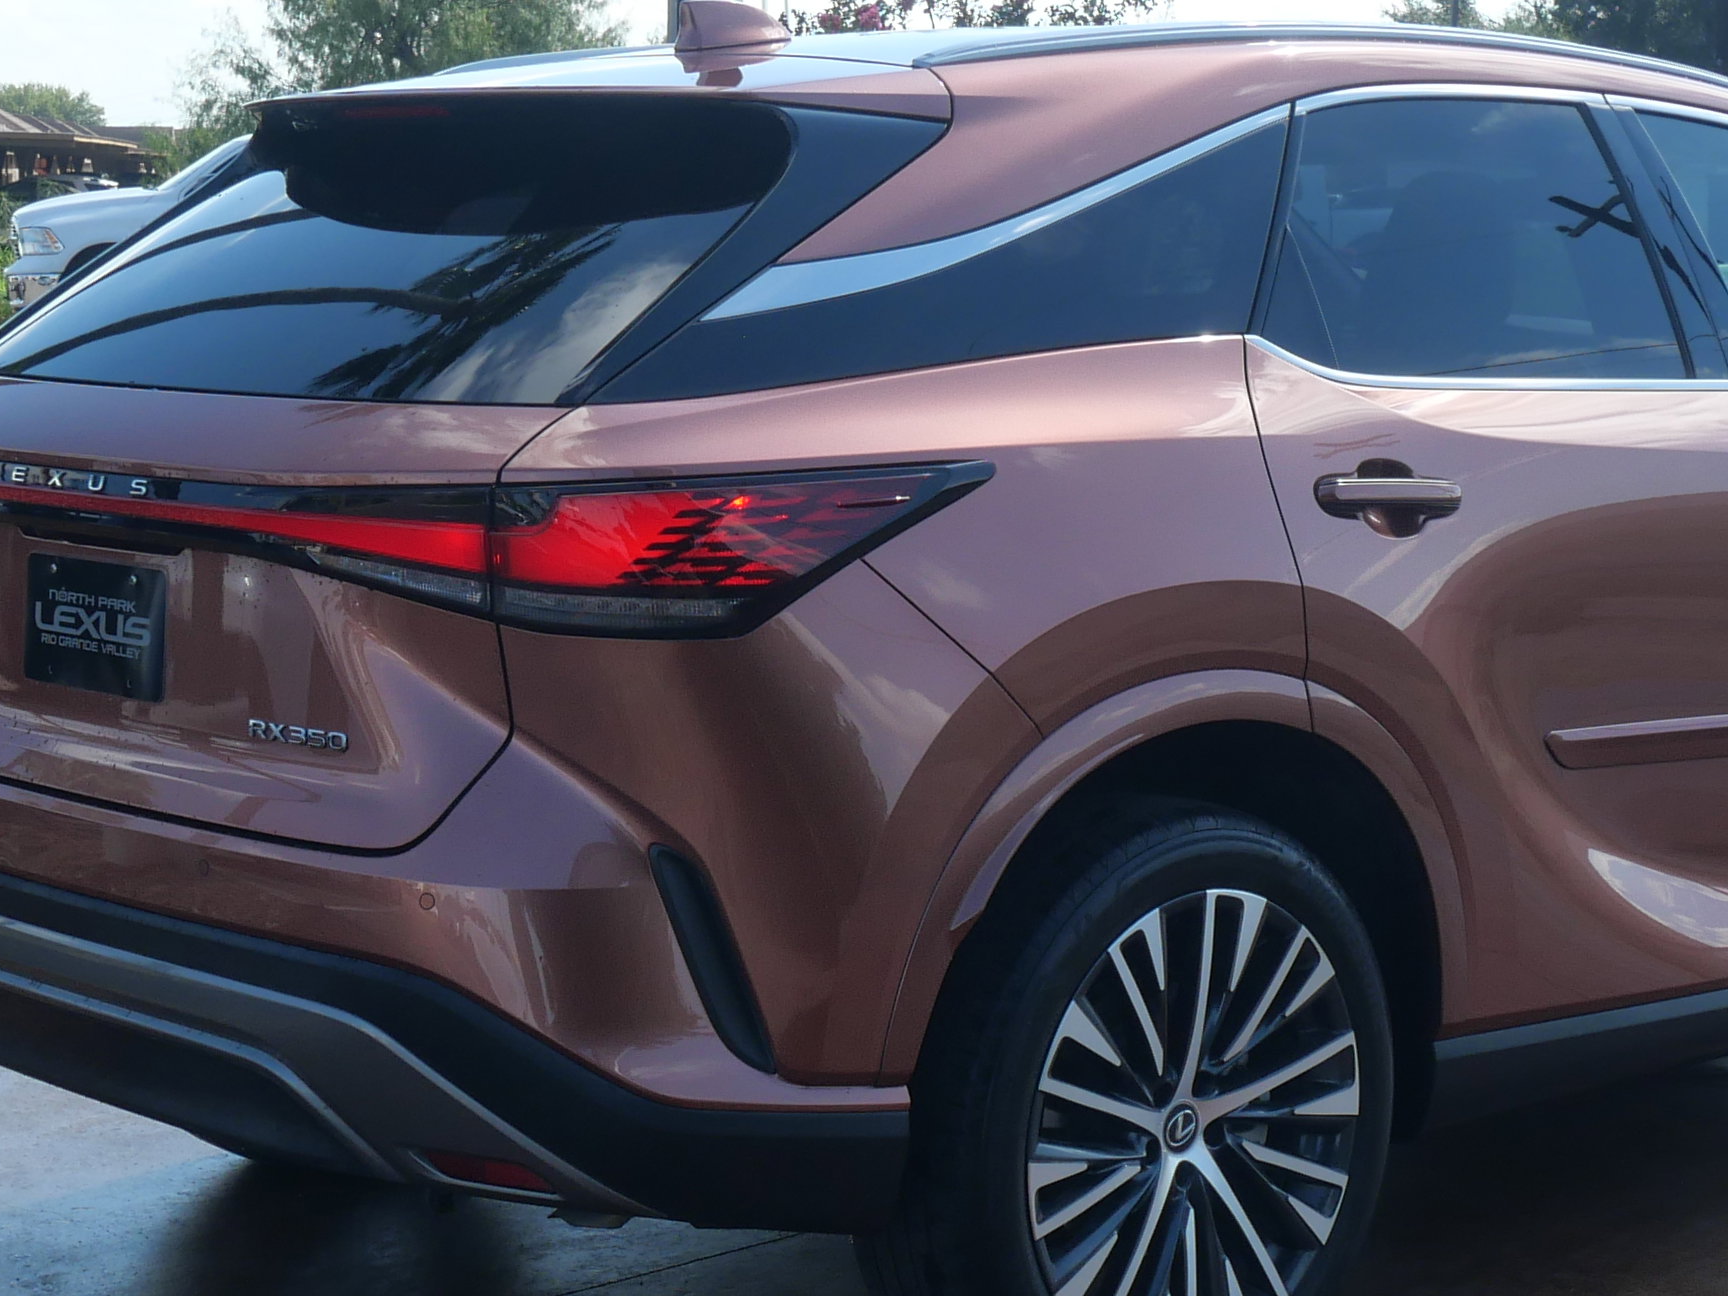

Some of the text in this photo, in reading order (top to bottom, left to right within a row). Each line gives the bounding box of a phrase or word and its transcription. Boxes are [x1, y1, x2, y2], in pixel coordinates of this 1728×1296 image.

[48, 588, 137, 613] NORTH PARK
[35, 601, 151, 647] LEXUS
[41, 632, 141, 659] RIO GRANDE VALLEY
[248, 718, 349, 752] RX350
